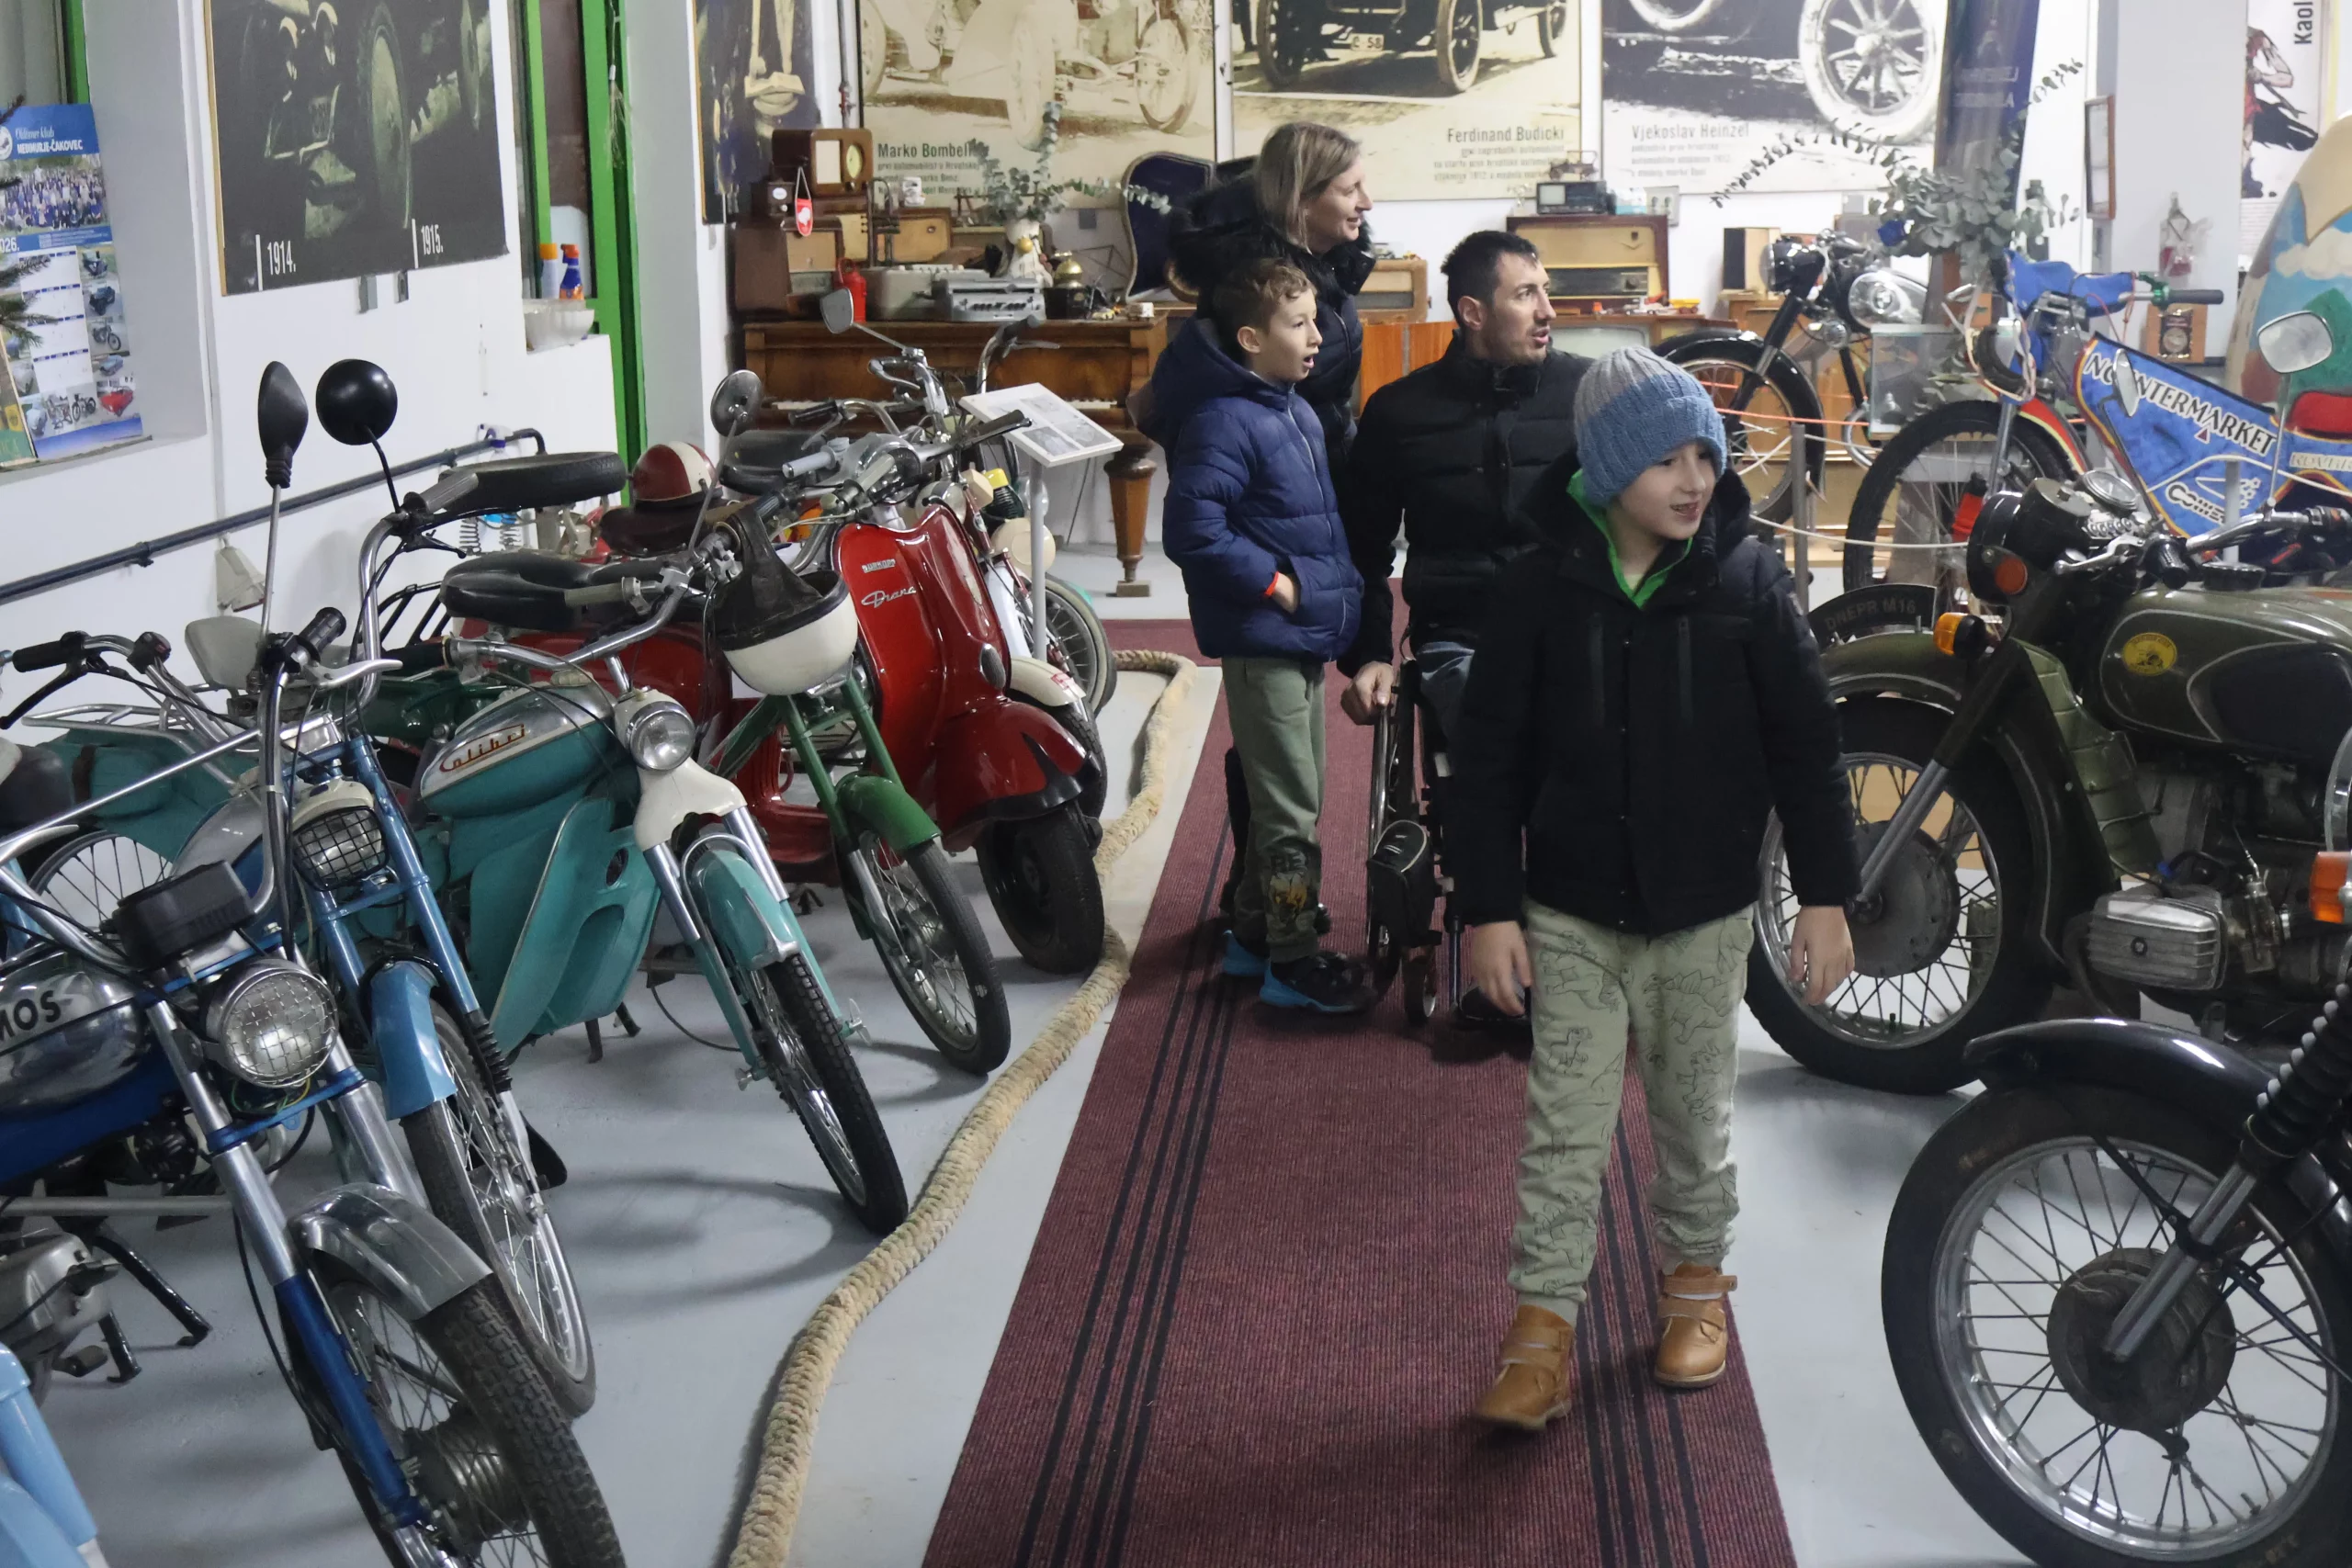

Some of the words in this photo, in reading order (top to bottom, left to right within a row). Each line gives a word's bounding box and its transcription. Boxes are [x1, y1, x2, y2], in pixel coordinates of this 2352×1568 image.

[1447, 128, 1512, 143] Ferdinand
[1516, 125, 1565, 141] Budicki
[1632, 125, 1696, 142] Vjekoslav
[1700, 120, 1749, 138] Heinzel
[877, 142, 918, 158] Marko
[421, 224, 444, 255] 1915.
[267, 240, 297, 276] 1914.
